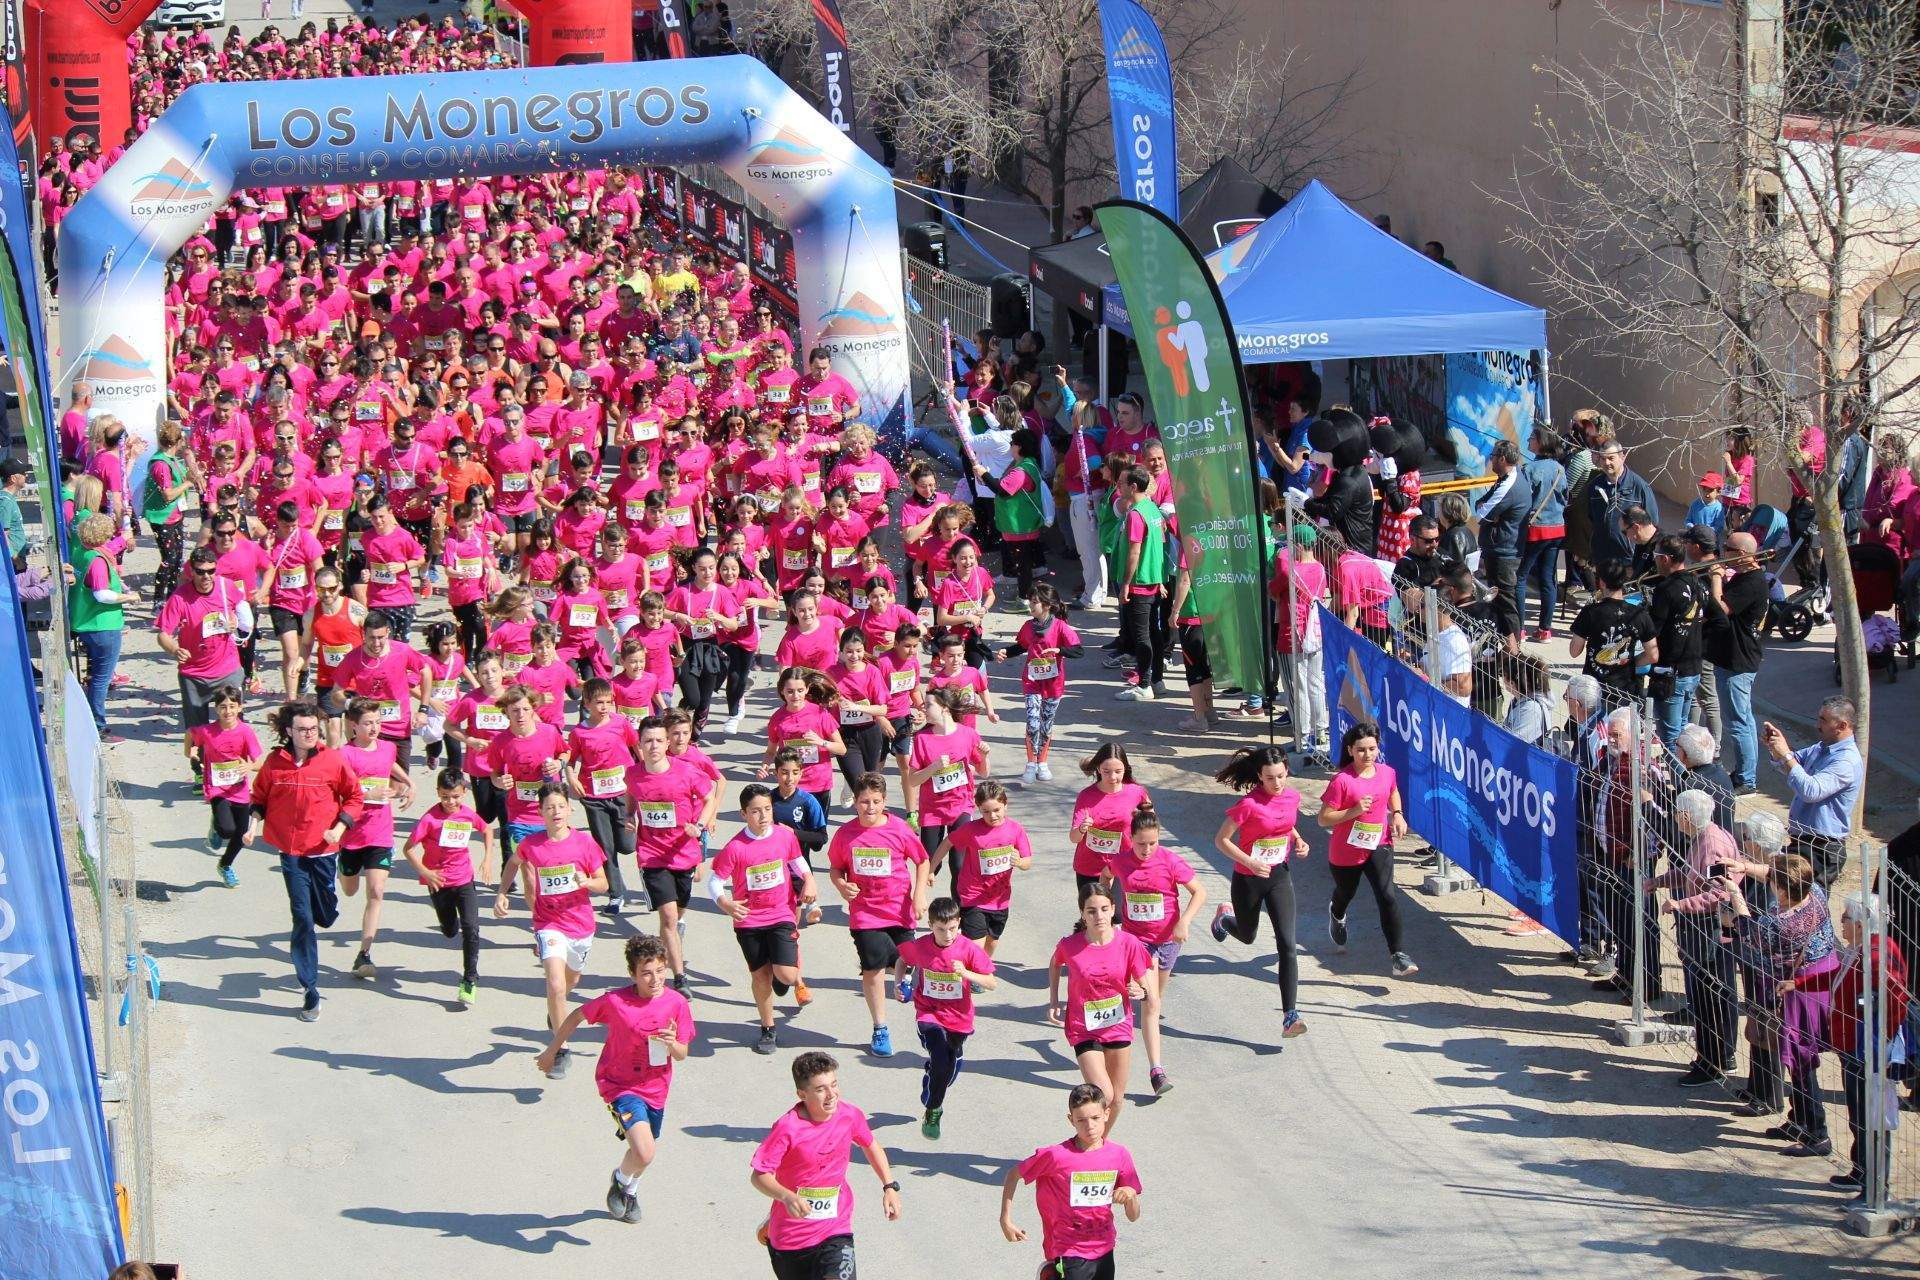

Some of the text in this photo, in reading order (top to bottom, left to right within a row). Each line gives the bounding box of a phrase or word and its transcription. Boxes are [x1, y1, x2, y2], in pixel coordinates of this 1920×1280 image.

[247, 83, 710, 151] Los Monegros
[251, 138, 567, 177] CONSEJO COMARCAL
[748, 167, 833, 180] Los Monegros
[131, 204, 152, 216] Los
[156, 200, 214, 217] Monegros
[843, 337, 902, 353] Monegros
[1243, 346, 1290, 357] COMARCAL
[95, 382, 158, 397] Monegros
[360, 408, 376, 416] 243
[813, 404, 829, 412] 317
[285, 574, 301, 584] 297
[374, 570, 391, 579] 266
[1033, 665, 1052, 674] 830
[482, 714, 503, 723] 841
[1384, 676, 1557, 838] Los Monegros
[938, 772, 960, 785] 309
[646, 811, 669, 821] 464
[1091, 835, 1114, 848] 569
[1356, 831, 1378, 842] 829
[1258, 846, 1280, 858] 789
[859, 858, 884, 869] 840
[986, 856, 1009, 868] 800
[546, 876, 570, 888] 303
[753, 871, 778, 884] 558
[1132, 902, 1156, 914] 831
[929, 981, 954, 993] 536
[1093, 1010, 1117, 1020] 461
[1079, 1184, 1108, 1197] 456
